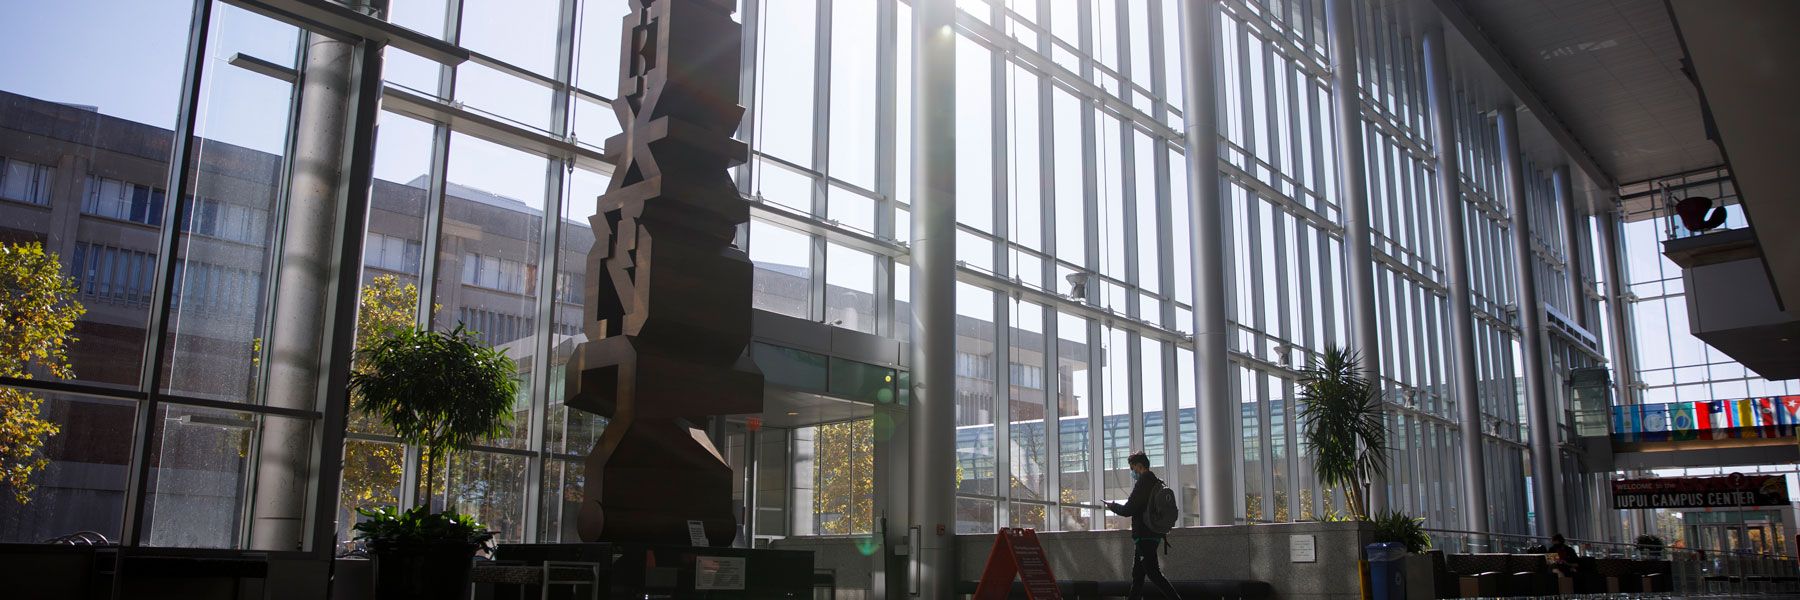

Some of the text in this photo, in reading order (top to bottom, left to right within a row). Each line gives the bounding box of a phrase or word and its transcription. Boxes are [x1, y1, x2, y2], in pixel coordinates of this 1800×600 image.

[748, 418, 760, 430] EXIT
[1617, 491, 1755, 508] IUPUI CAMPUS CENTER
